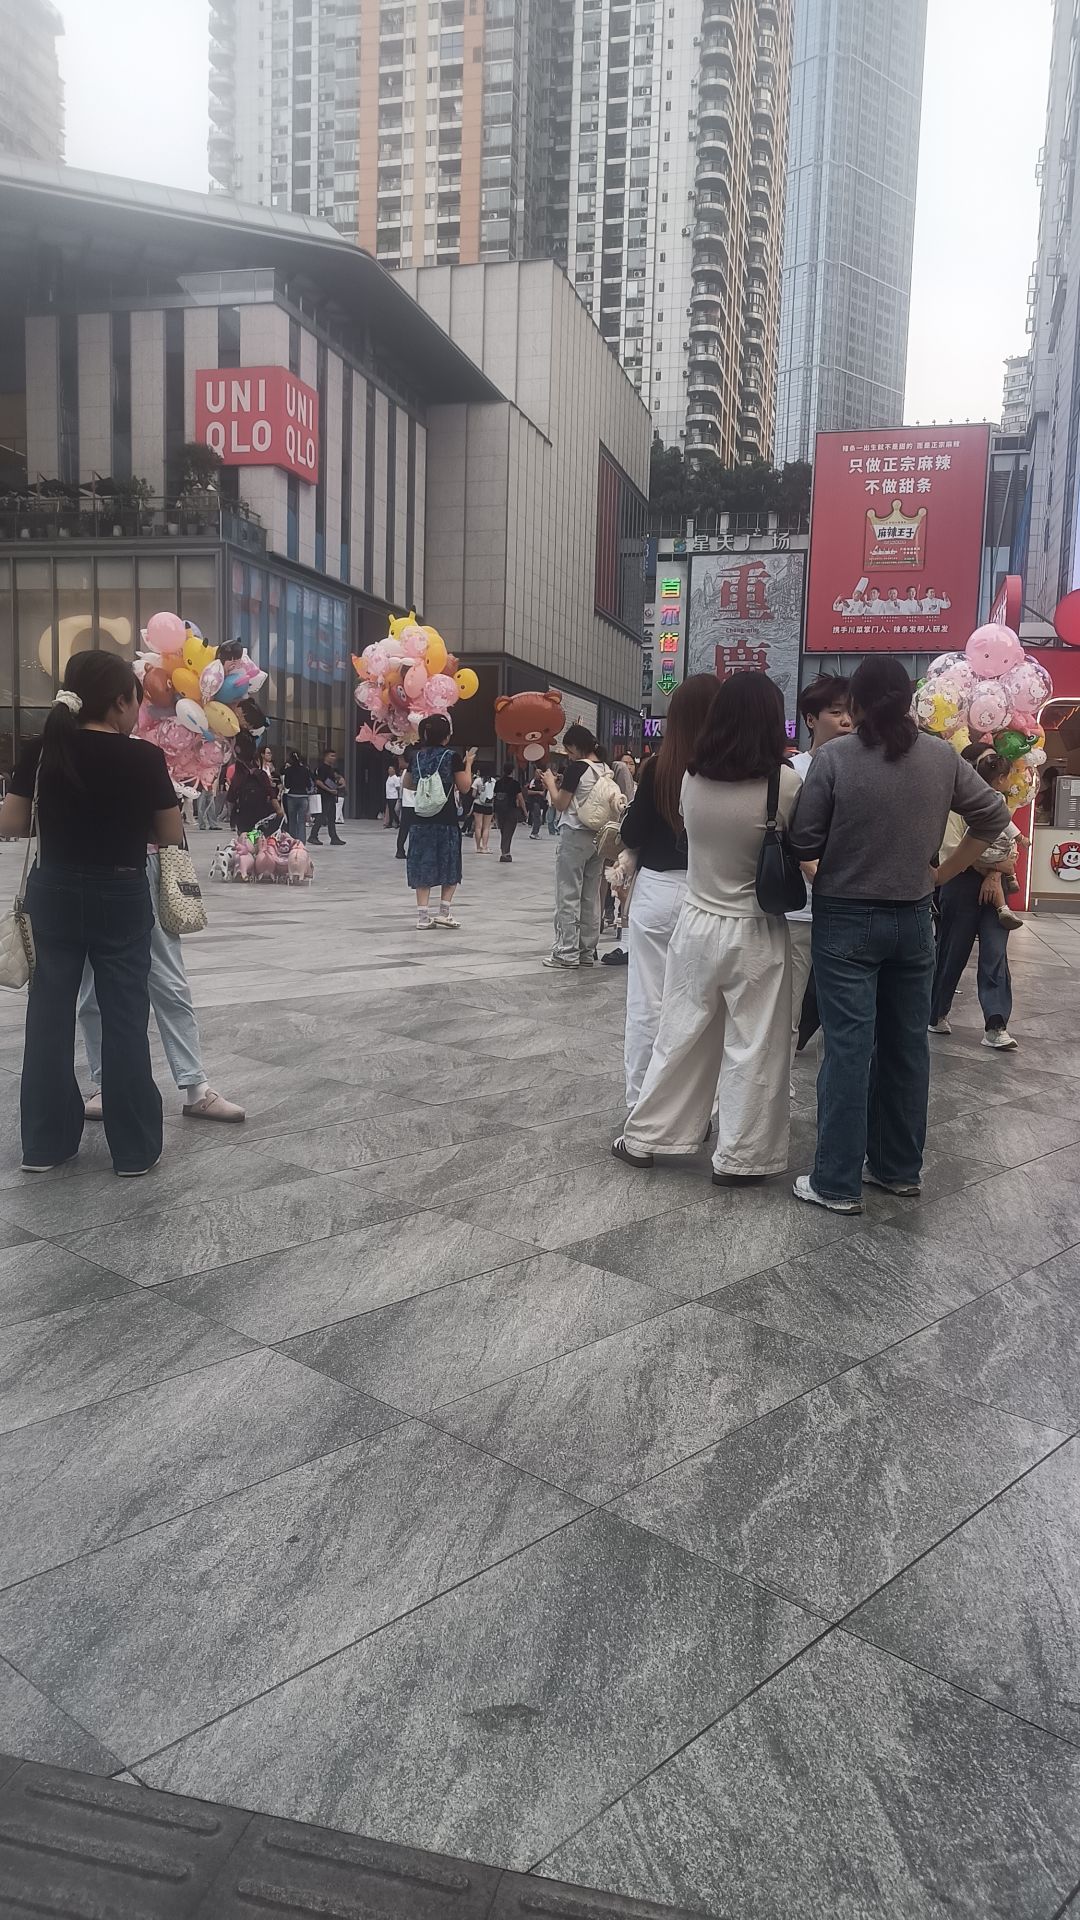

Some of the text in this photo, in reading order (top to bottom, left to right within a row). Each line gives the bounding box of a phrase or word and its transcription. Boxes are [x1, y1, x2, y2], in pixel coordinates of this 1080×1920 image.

[206, 379, 267, 414] UNI
[286, 381, 313, 432] UNI
[206, 419, 272, 459] QLO
[286, 424, 316, 470] QLO
[848, 454, 952, 474] 只做正宗麻辣
[865, 477, 932, 495] 不做甜条
[693, 529, 790, 552] 星天广场
[877, 526, 915, 539] 麻辣王子
